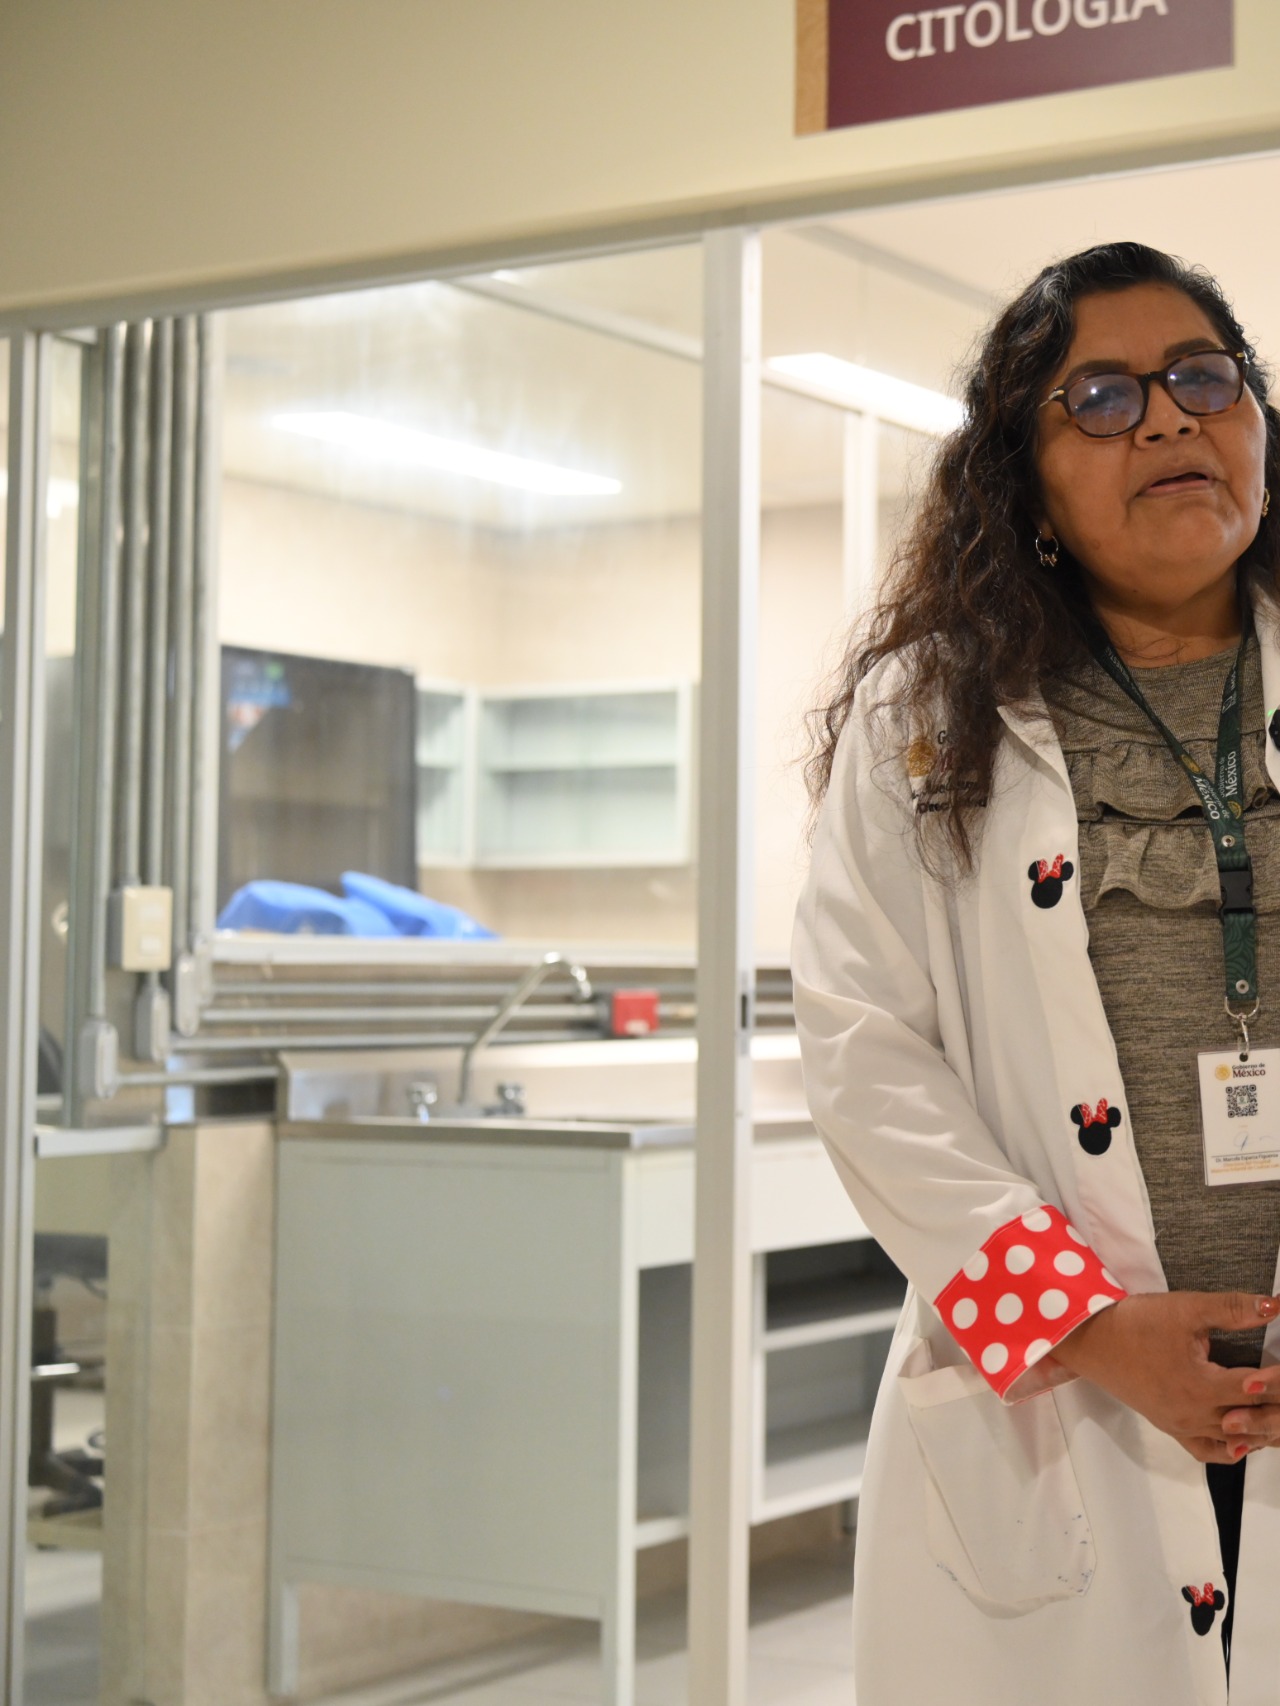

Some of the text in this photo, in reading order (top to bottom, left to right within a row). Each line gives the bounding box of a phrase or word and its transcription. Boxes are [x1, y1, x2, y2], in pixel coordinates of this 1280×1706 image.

[1225, 751, 1238, 797] México
[1192, 775, 1220, 820] México
[1232, 1068, 1266, 1078] México
